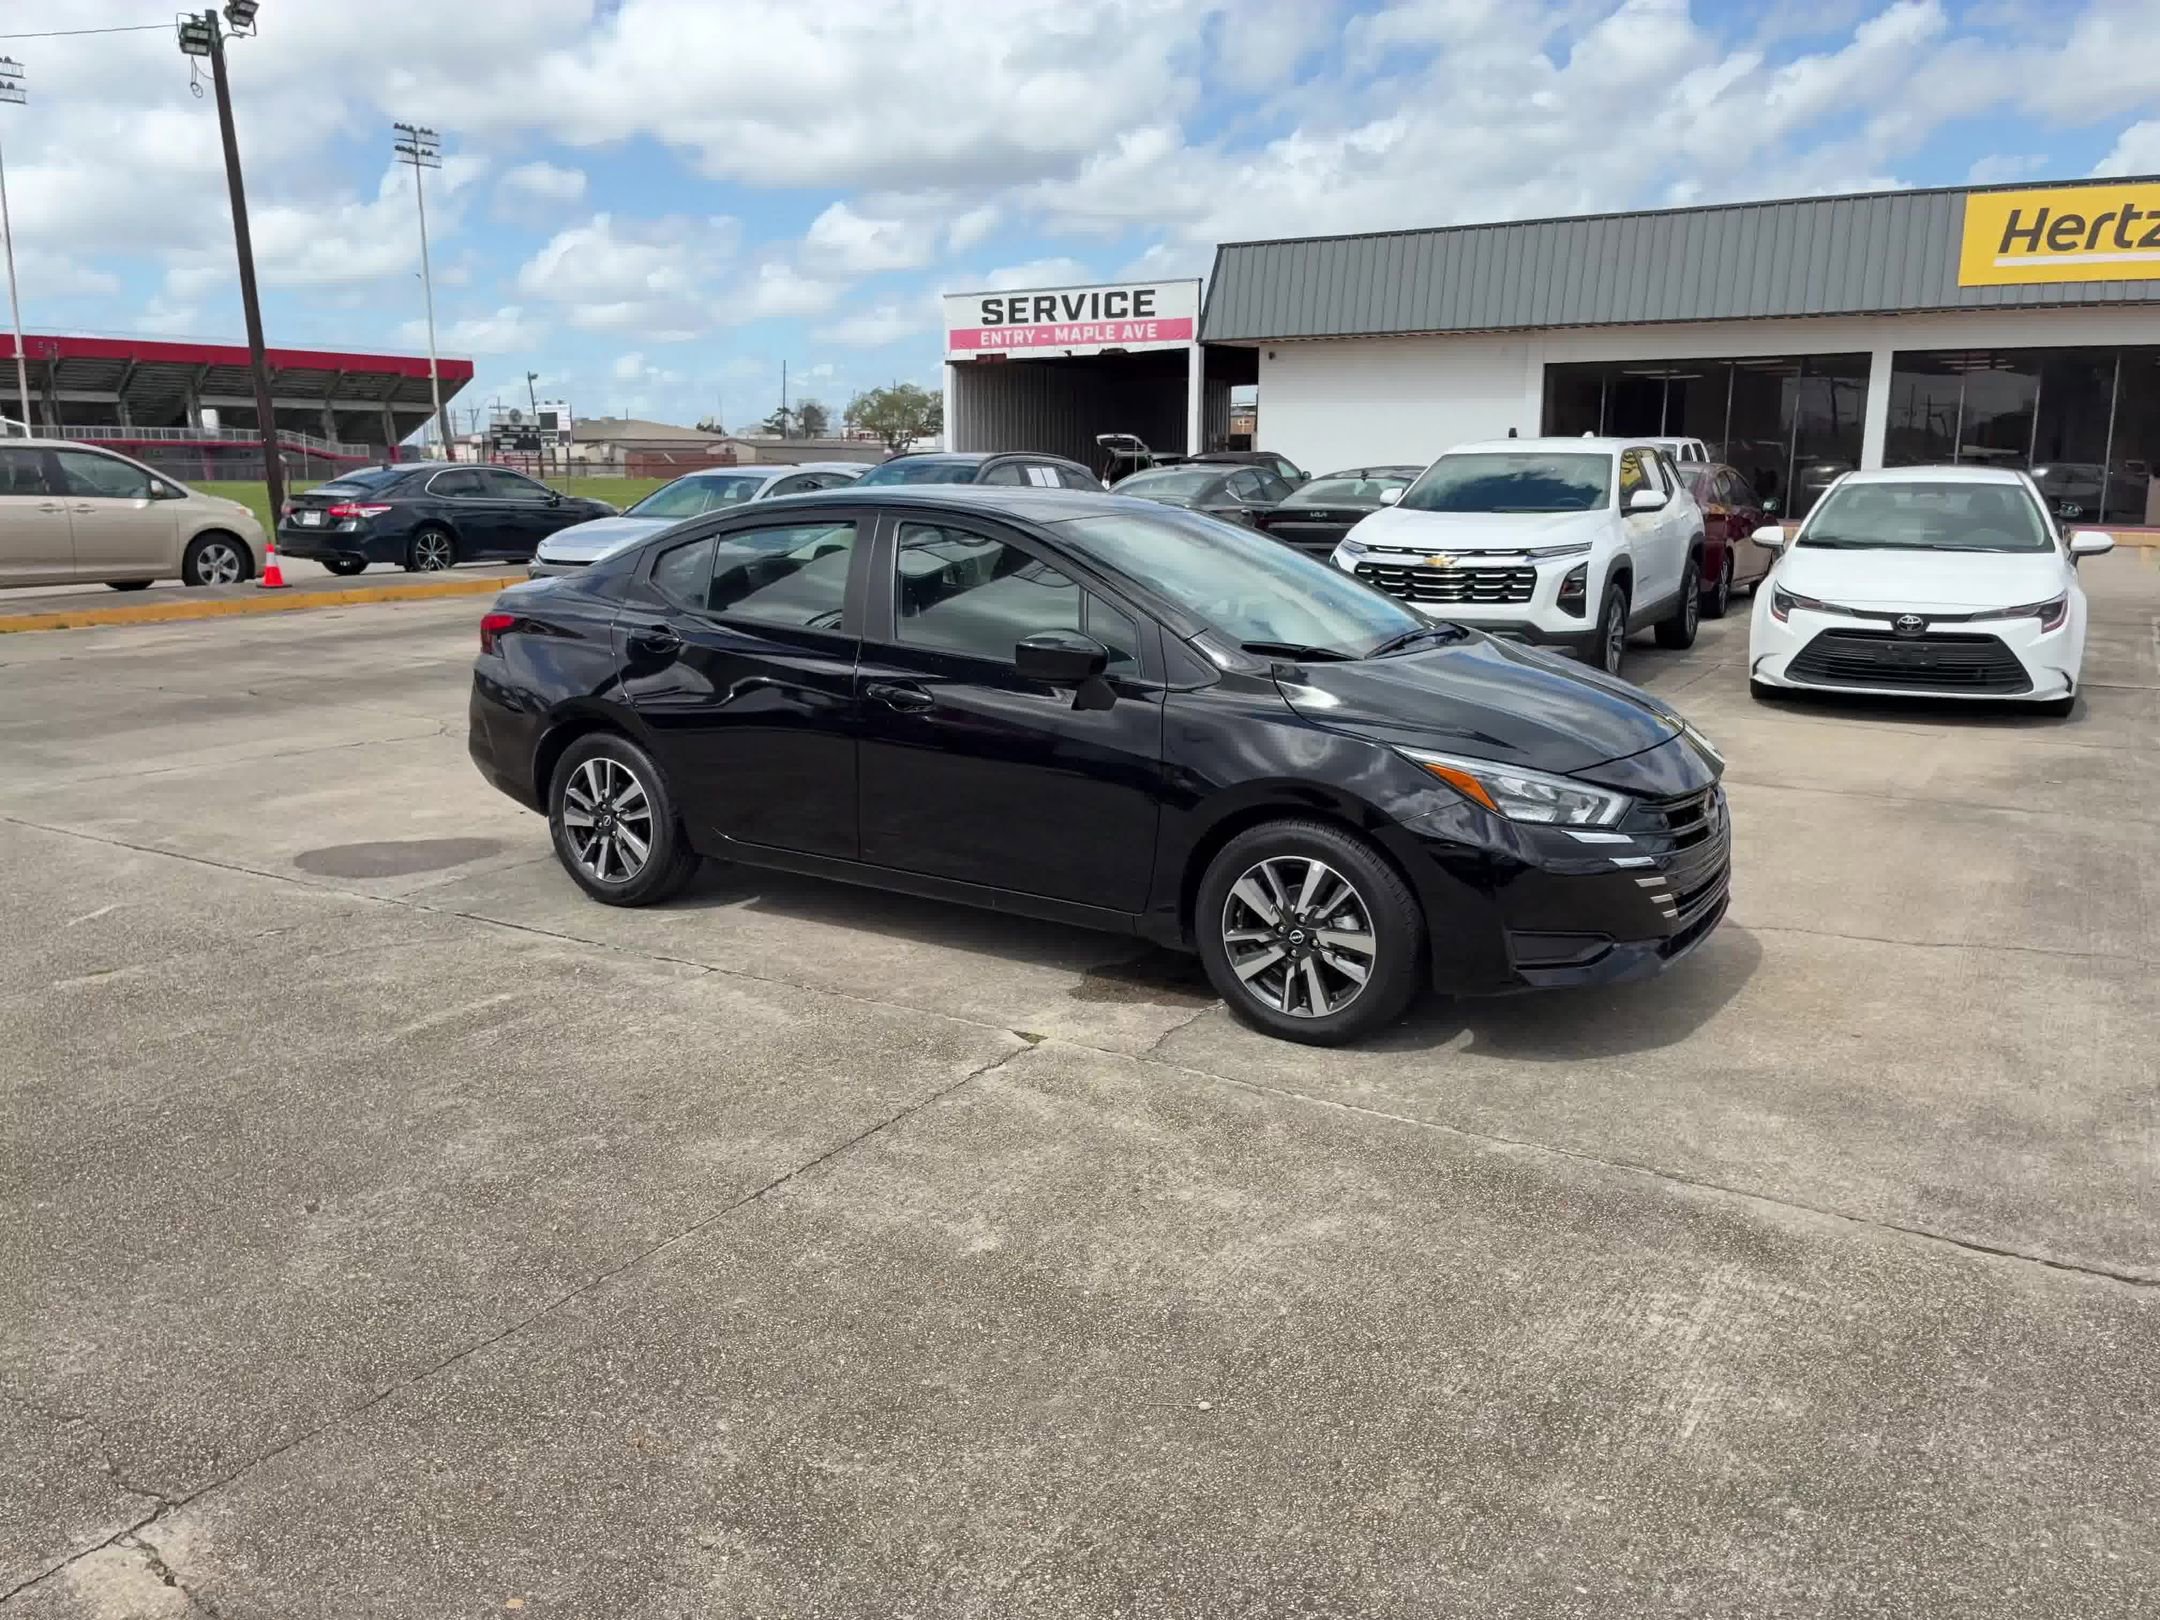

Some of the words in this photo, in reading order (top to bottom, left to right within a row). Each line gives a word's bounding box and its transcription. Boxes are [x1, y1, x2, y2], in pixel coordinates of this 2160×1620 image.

[1998, 203, 2160, 254] Hertz
[981, 289, 1156, 326] SERVICE
[980, 329, 1036, 346] ENTRY
[1054, 325, 1116, 342] MAPLE
[1122, 323, 1158, 339] AVE
